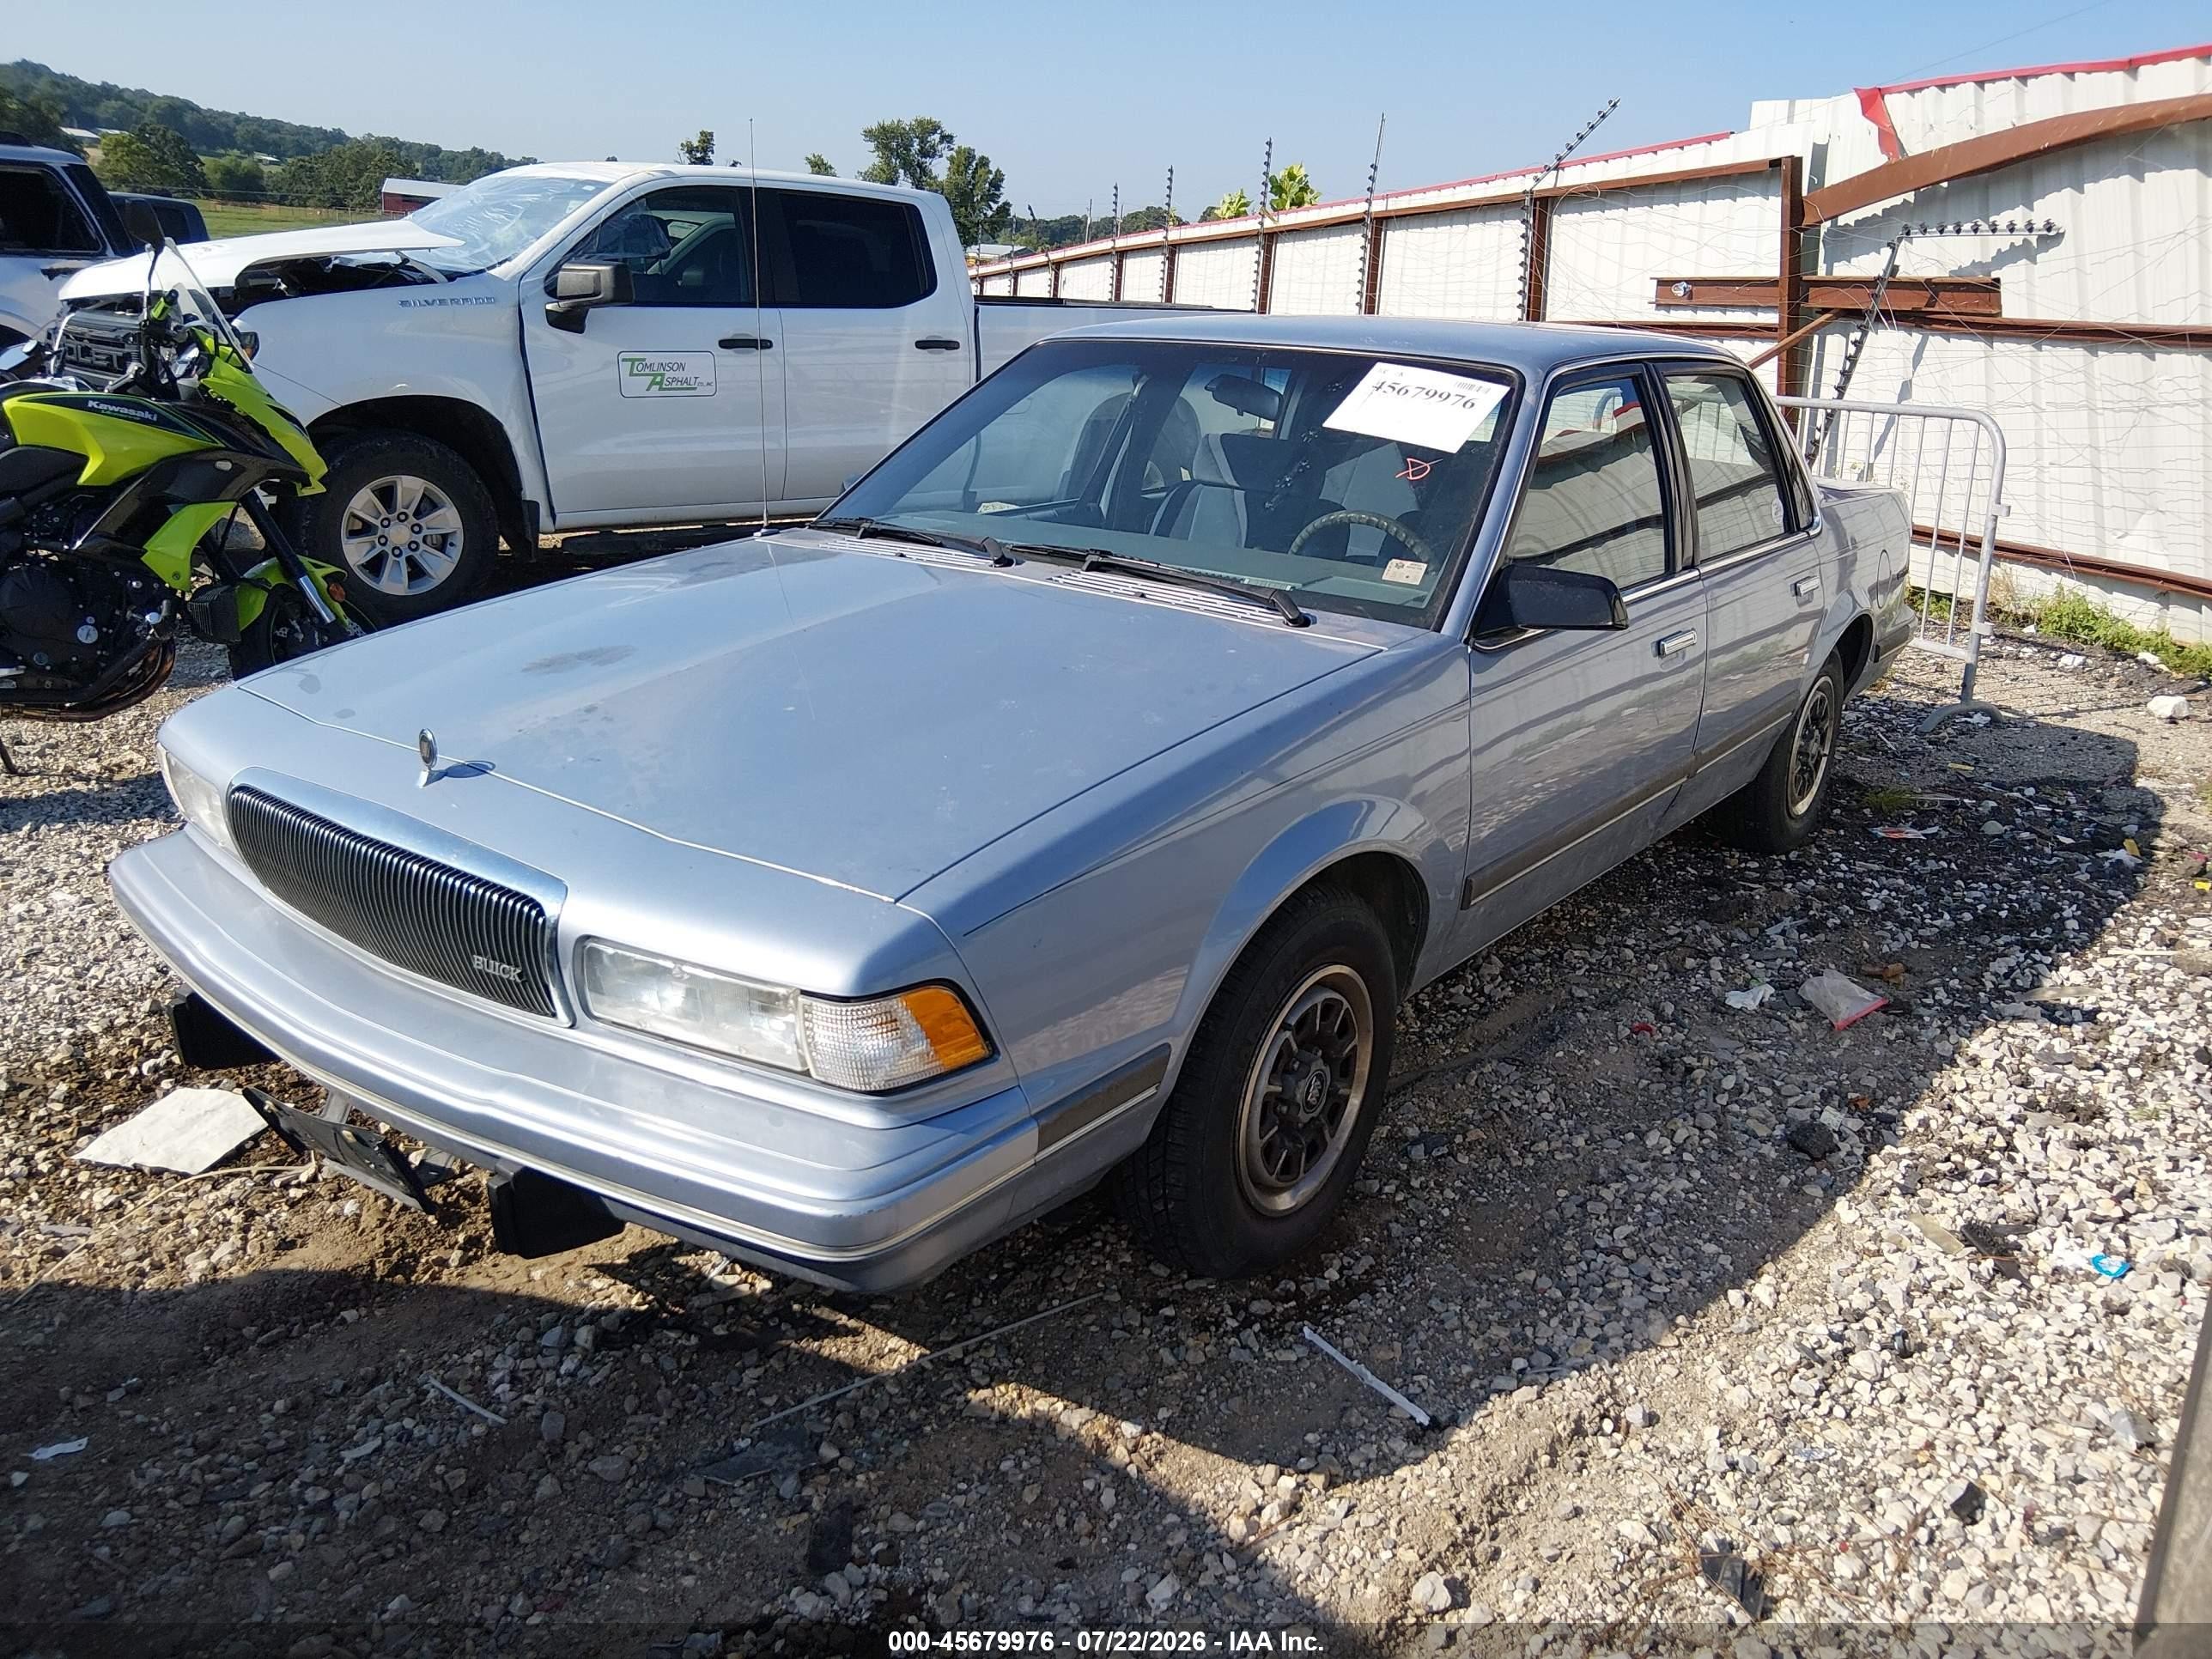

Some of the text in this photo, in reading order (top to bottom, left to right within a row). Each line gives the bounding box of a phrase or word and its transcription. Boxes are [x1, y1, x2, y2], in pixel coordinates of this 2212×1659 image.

[398, 296, 495, 308] SILVERADO
[622, 357, 687, 377] TOMLINSON
[645, 373, 700, 392] ASPHALT
[1373, 380, 1477, 410] 45679976
[88, 400, 158, 422] Kawasaki
[473, 955, 523, 983] BUICK
